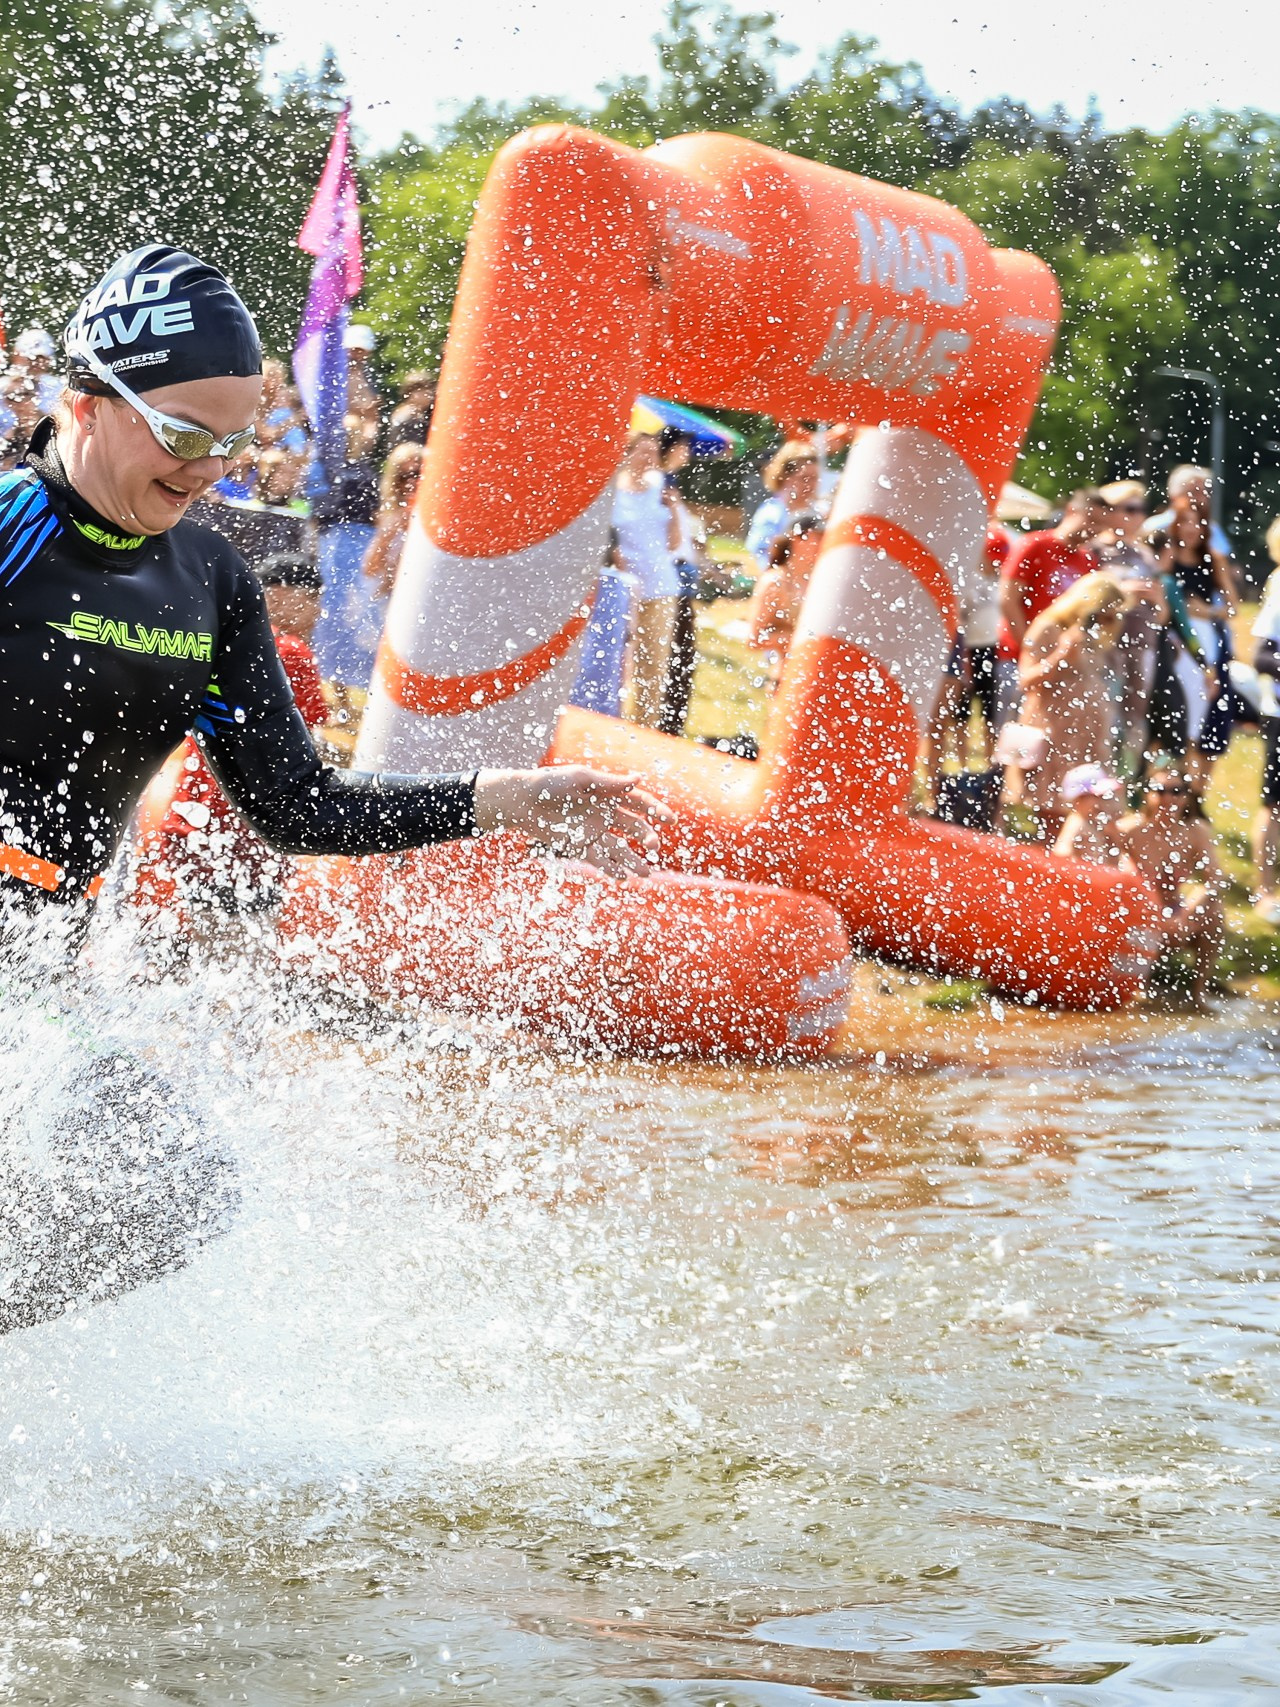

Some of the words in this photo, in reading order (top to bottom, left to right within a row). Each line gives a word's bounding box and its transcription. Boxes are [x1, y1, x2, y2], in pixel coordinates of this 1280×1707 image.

[851, 210, 967, 308] MAD
[79, 273, 171, 319] MAD
[113, 358, 170, 373] CHAMPIONSHIP
